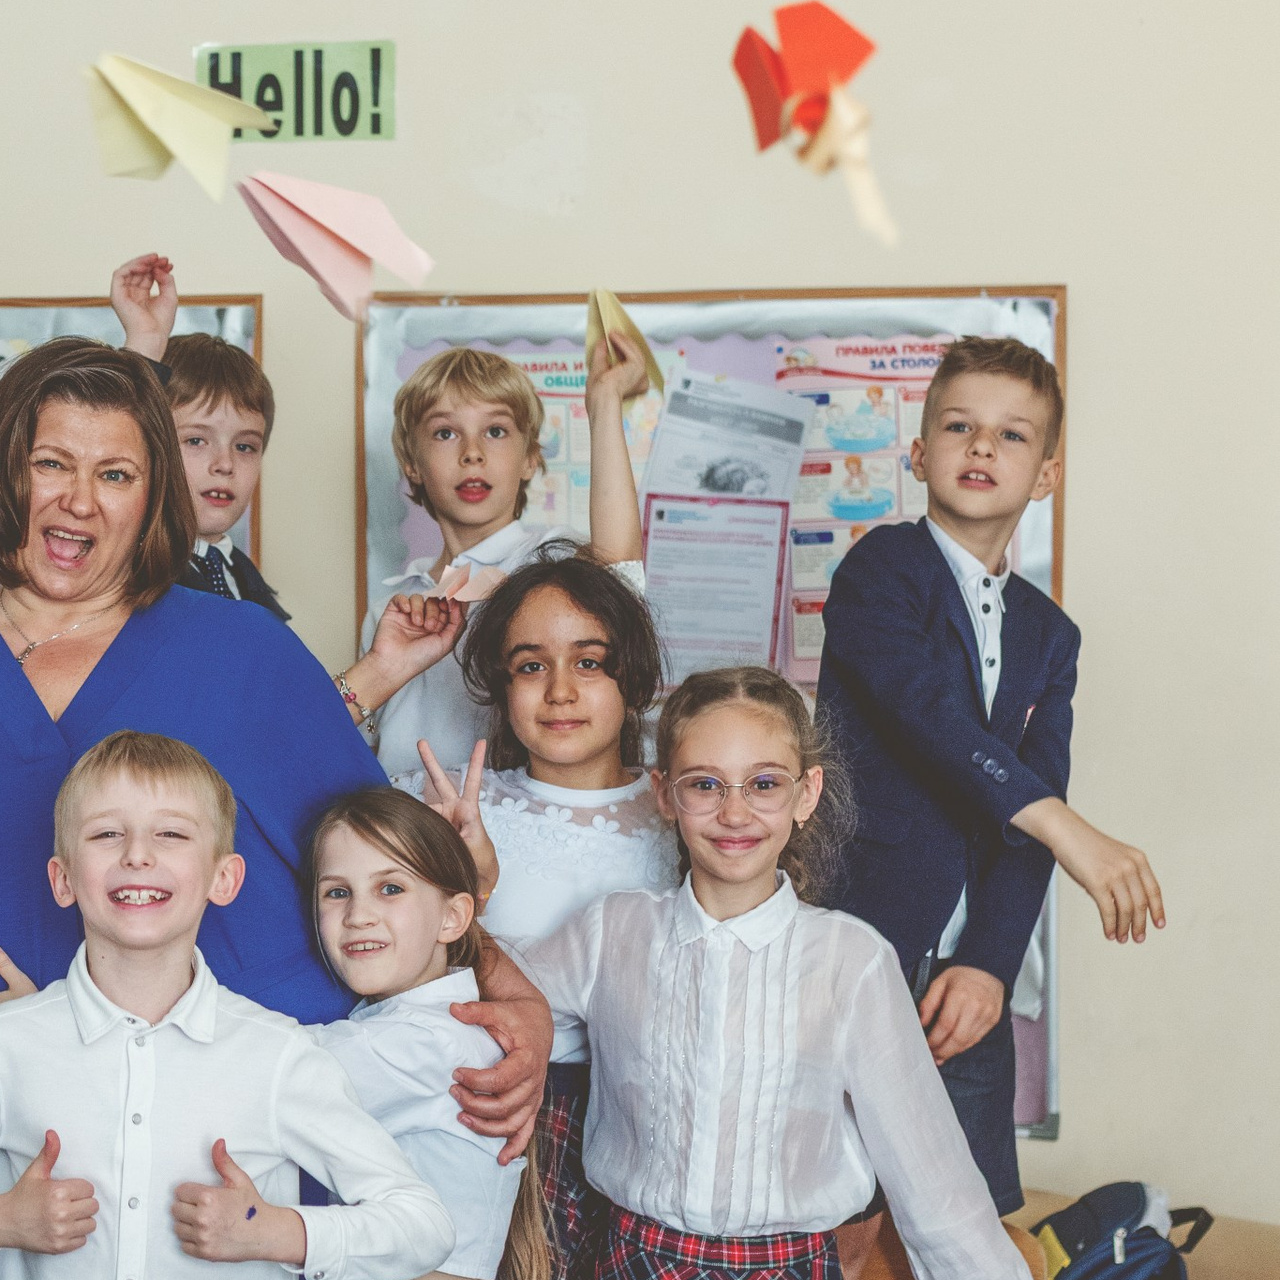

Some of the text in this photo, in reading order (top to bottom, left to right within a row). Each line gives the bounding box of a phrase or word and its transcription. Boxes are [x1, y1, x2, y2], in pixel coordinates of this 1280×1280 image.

[208, 47, 382, 138] Hello!
[835, 345, 897, 357] ПРАВИЛА
[870, 359, 886, 370] ЗА
